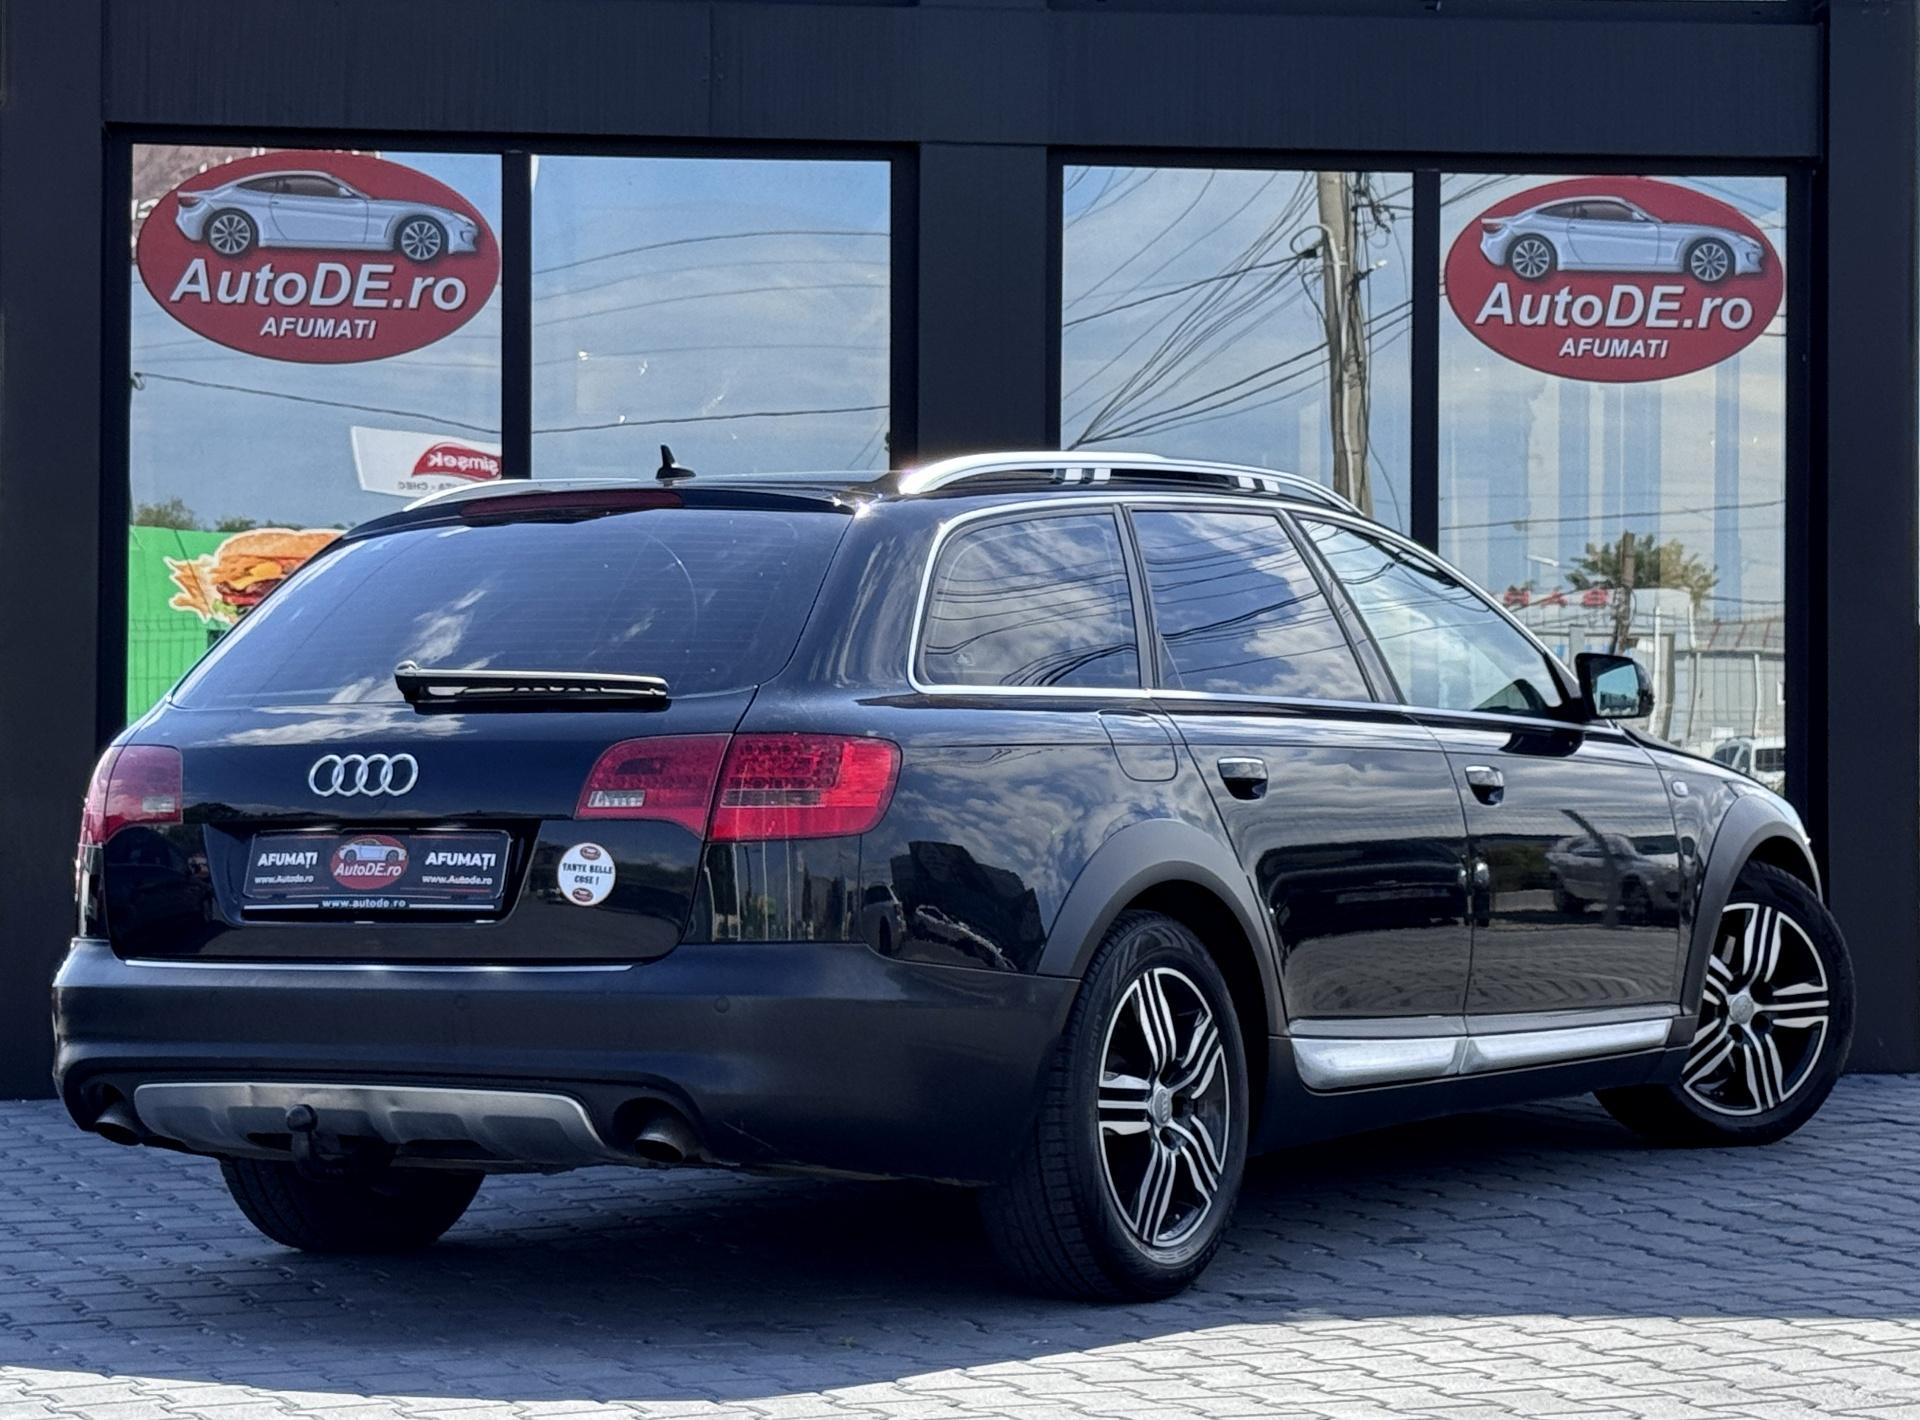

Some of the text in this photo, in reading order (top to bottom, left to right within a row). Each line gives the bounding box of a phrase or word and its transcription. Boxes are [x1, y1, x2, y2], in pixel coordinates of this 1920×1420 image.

[170, 257, 467, 311] AutoDE.ro
[1475, 282, 1753, 330] AutoDE.ro
[260, 316, 377, 340] AFUMATI
[1559, 337, 1669, 359] AFUMATI
[333, 862, 402, 877] AutoDE.ro
[322, 898, 406, 909] www.autode.ro
